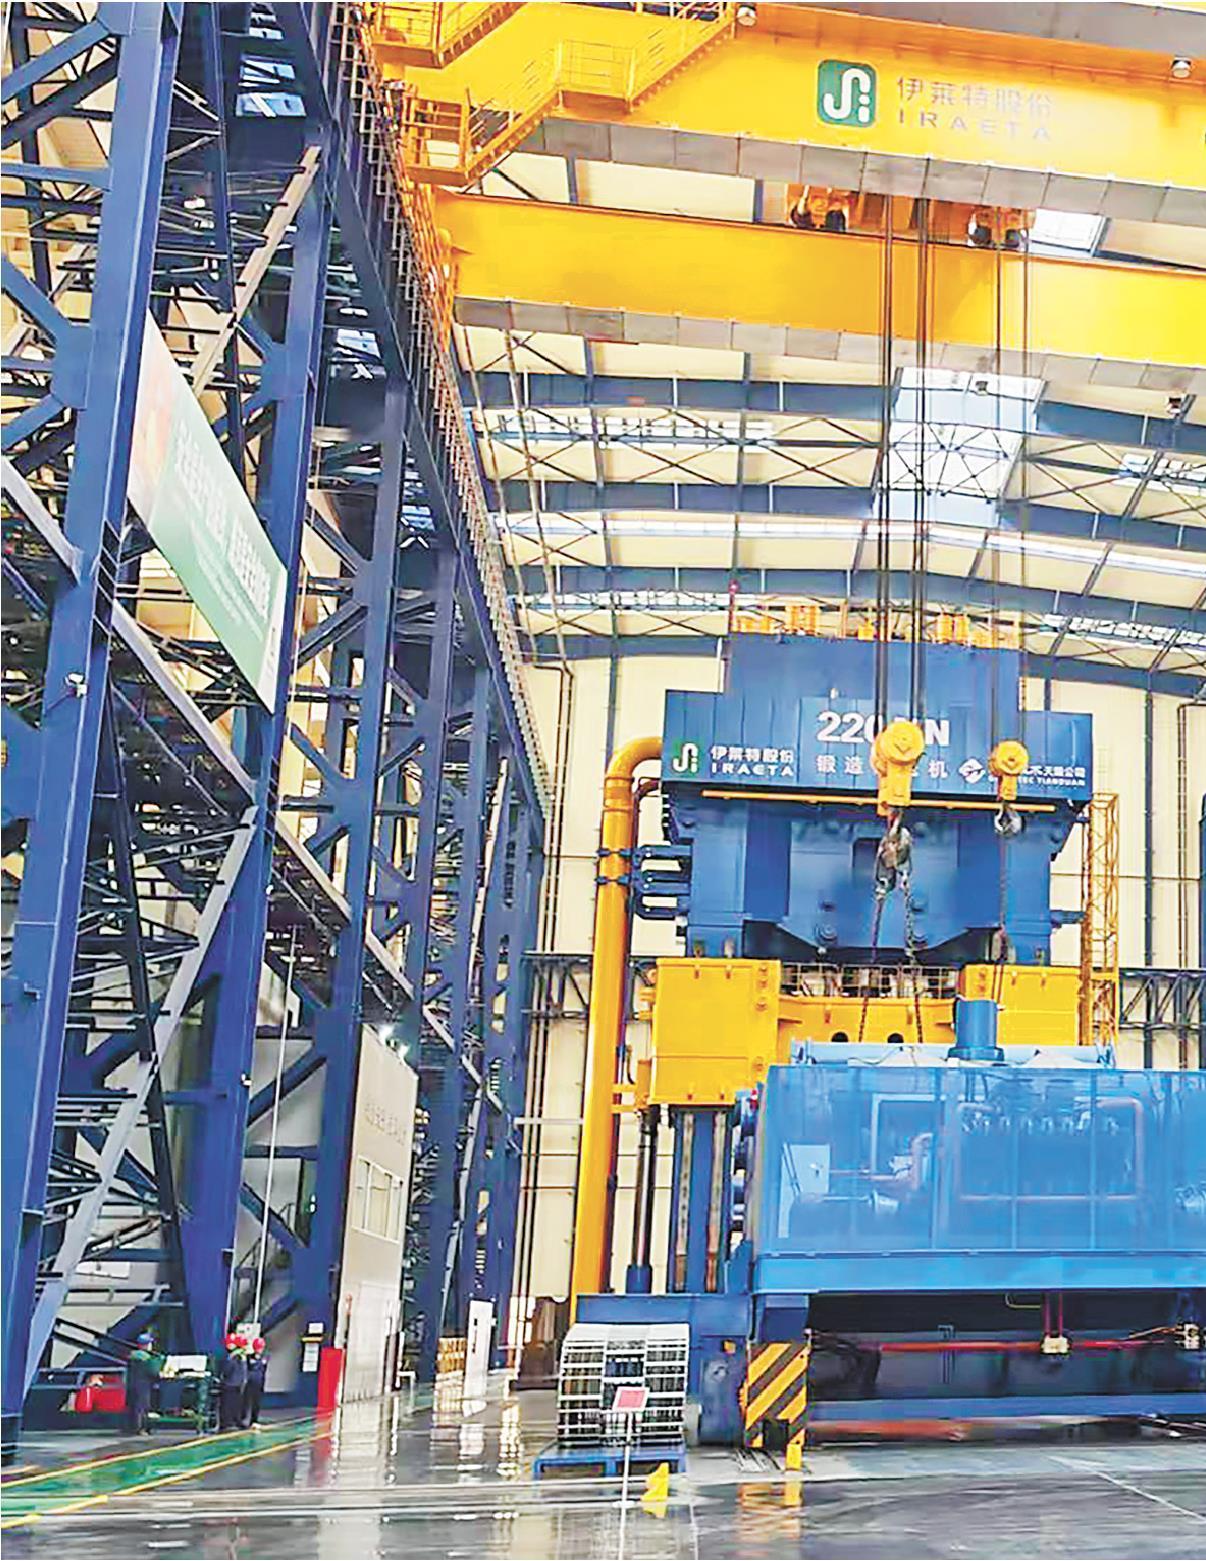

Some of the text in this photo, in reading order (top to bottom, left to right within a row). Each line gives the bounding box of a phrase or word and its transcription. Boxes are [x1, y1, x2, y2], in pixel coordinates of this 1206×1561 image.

[897, 76, 1051, 119] 伊莱特股份
[899, 108, 1050, 140] IRAETA
[817, 711, 950, 746] 220N
[711, 762, 794, 777] IRAETA
[816, 754, 949, 778] 锻造机
